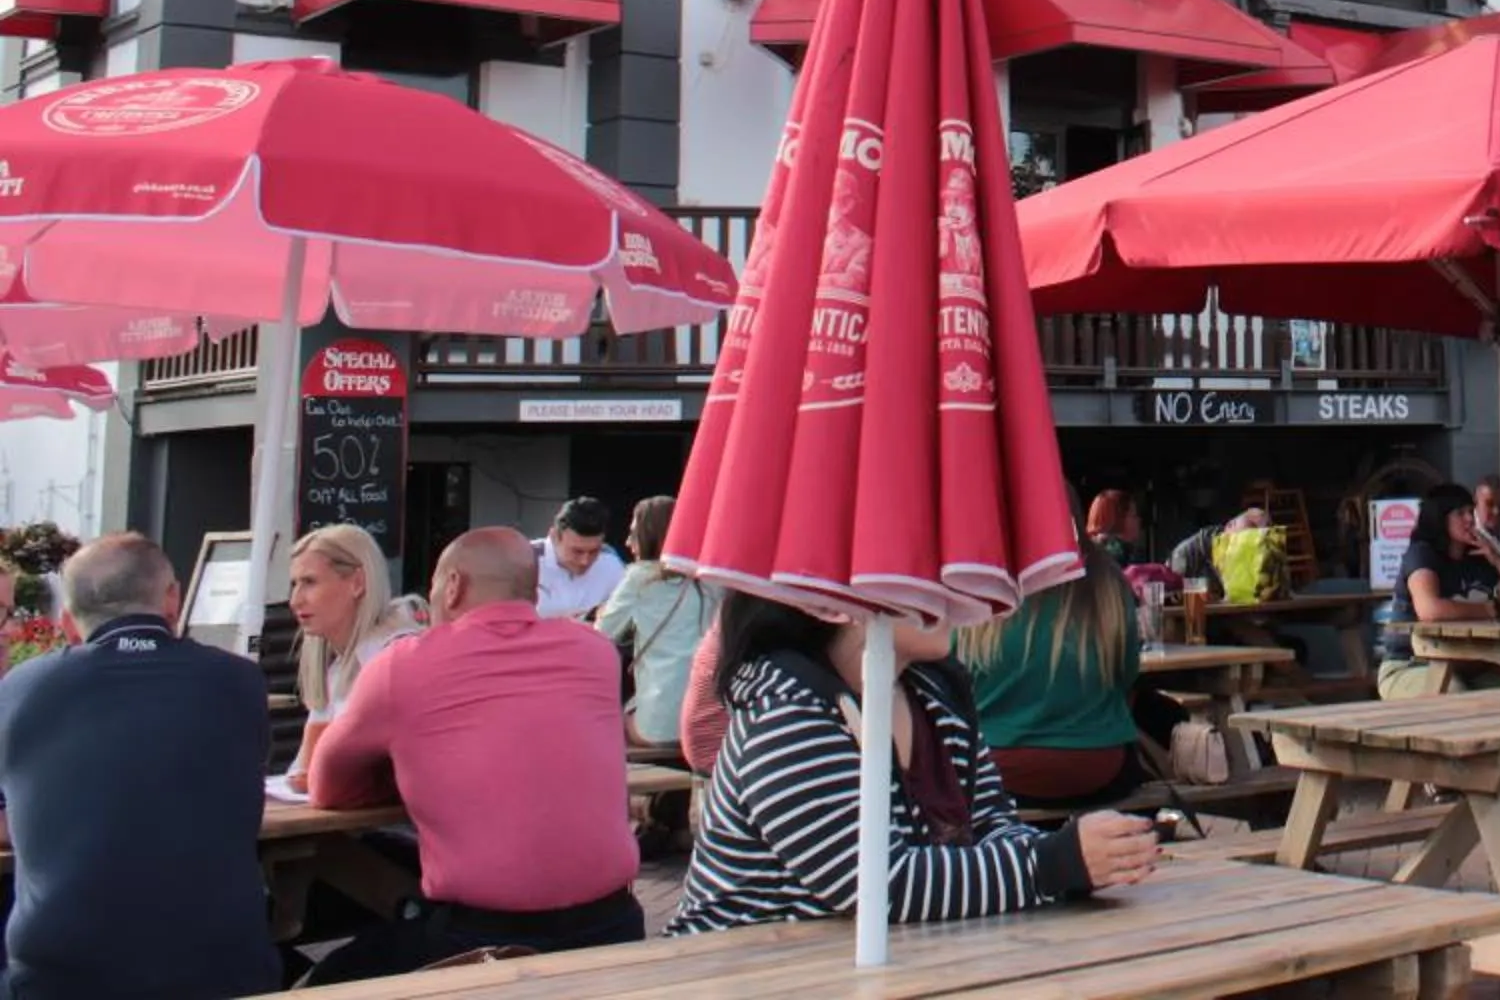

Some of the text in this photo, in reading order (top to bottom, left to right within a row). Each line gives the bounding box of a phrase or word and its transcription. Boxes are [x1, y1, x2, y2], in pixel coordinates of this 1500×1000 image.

[324, 348, 396, 369] SPECIAL
[324, 370, 391, 394] OFFERS
[608, 404, 637, 416] YOUR
[1155, 391, 1255, 423] NO Entry
[1318, 395, 1409, 420] STEAKS
[312, 433, 380, 480] 50%
